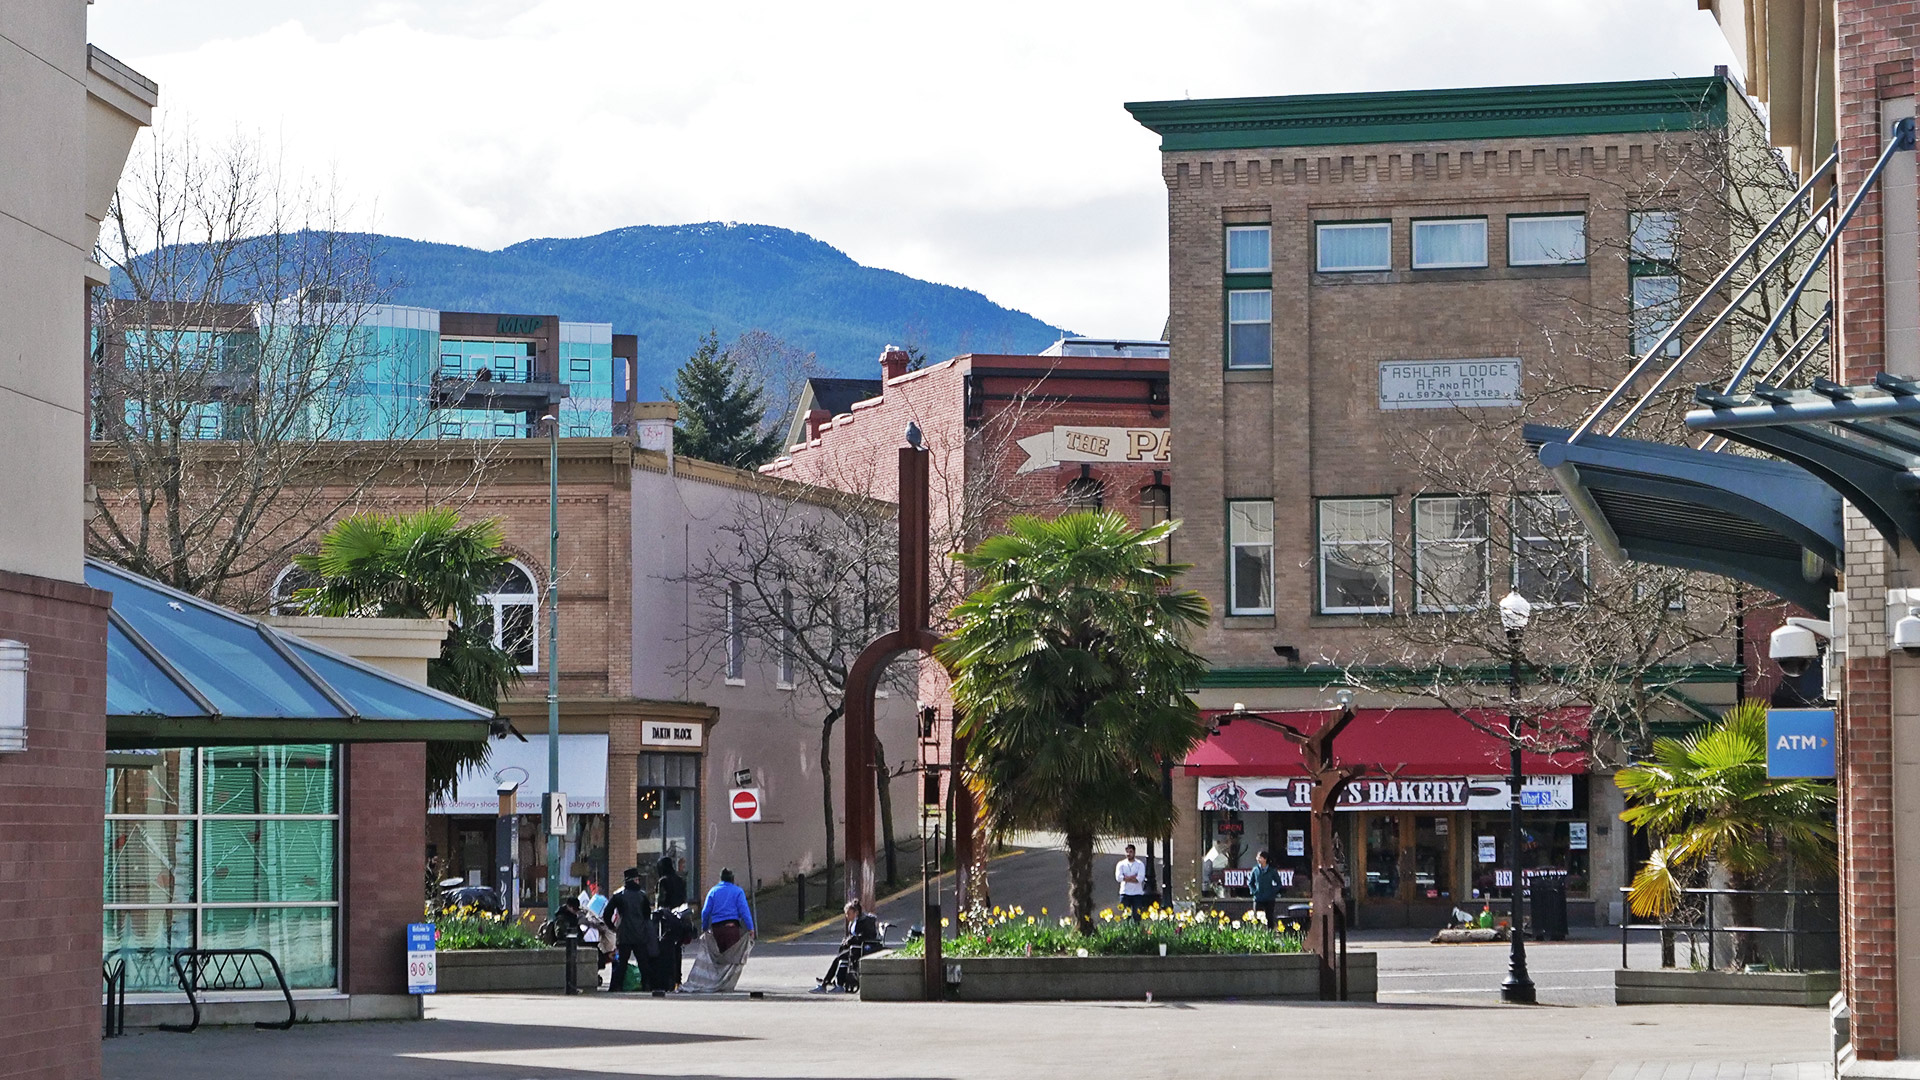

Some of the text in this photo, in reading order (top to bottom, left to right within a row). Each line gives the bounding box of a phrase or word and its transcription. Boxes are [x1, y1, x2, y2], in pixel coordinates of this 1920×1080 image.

[496, 316, 543, 334] MNP
[1392, 364, 1509, 379] ASHLAR LODGE
[1416, 379, 1436, 390] AF
[1462, 377, 1485, 389] AM
[1066, 430, 1110, 457] THE
[673, 727, 693, 741] BLOCK
[1776, 735, 1817, 750] ATM
[1294, 781, 1466, 804] R'S BAKERY
[1521, 792, 1540, 805] Wharf
[568, 801, 584, 809] baby
[585, 801, 601, 809] gifts
